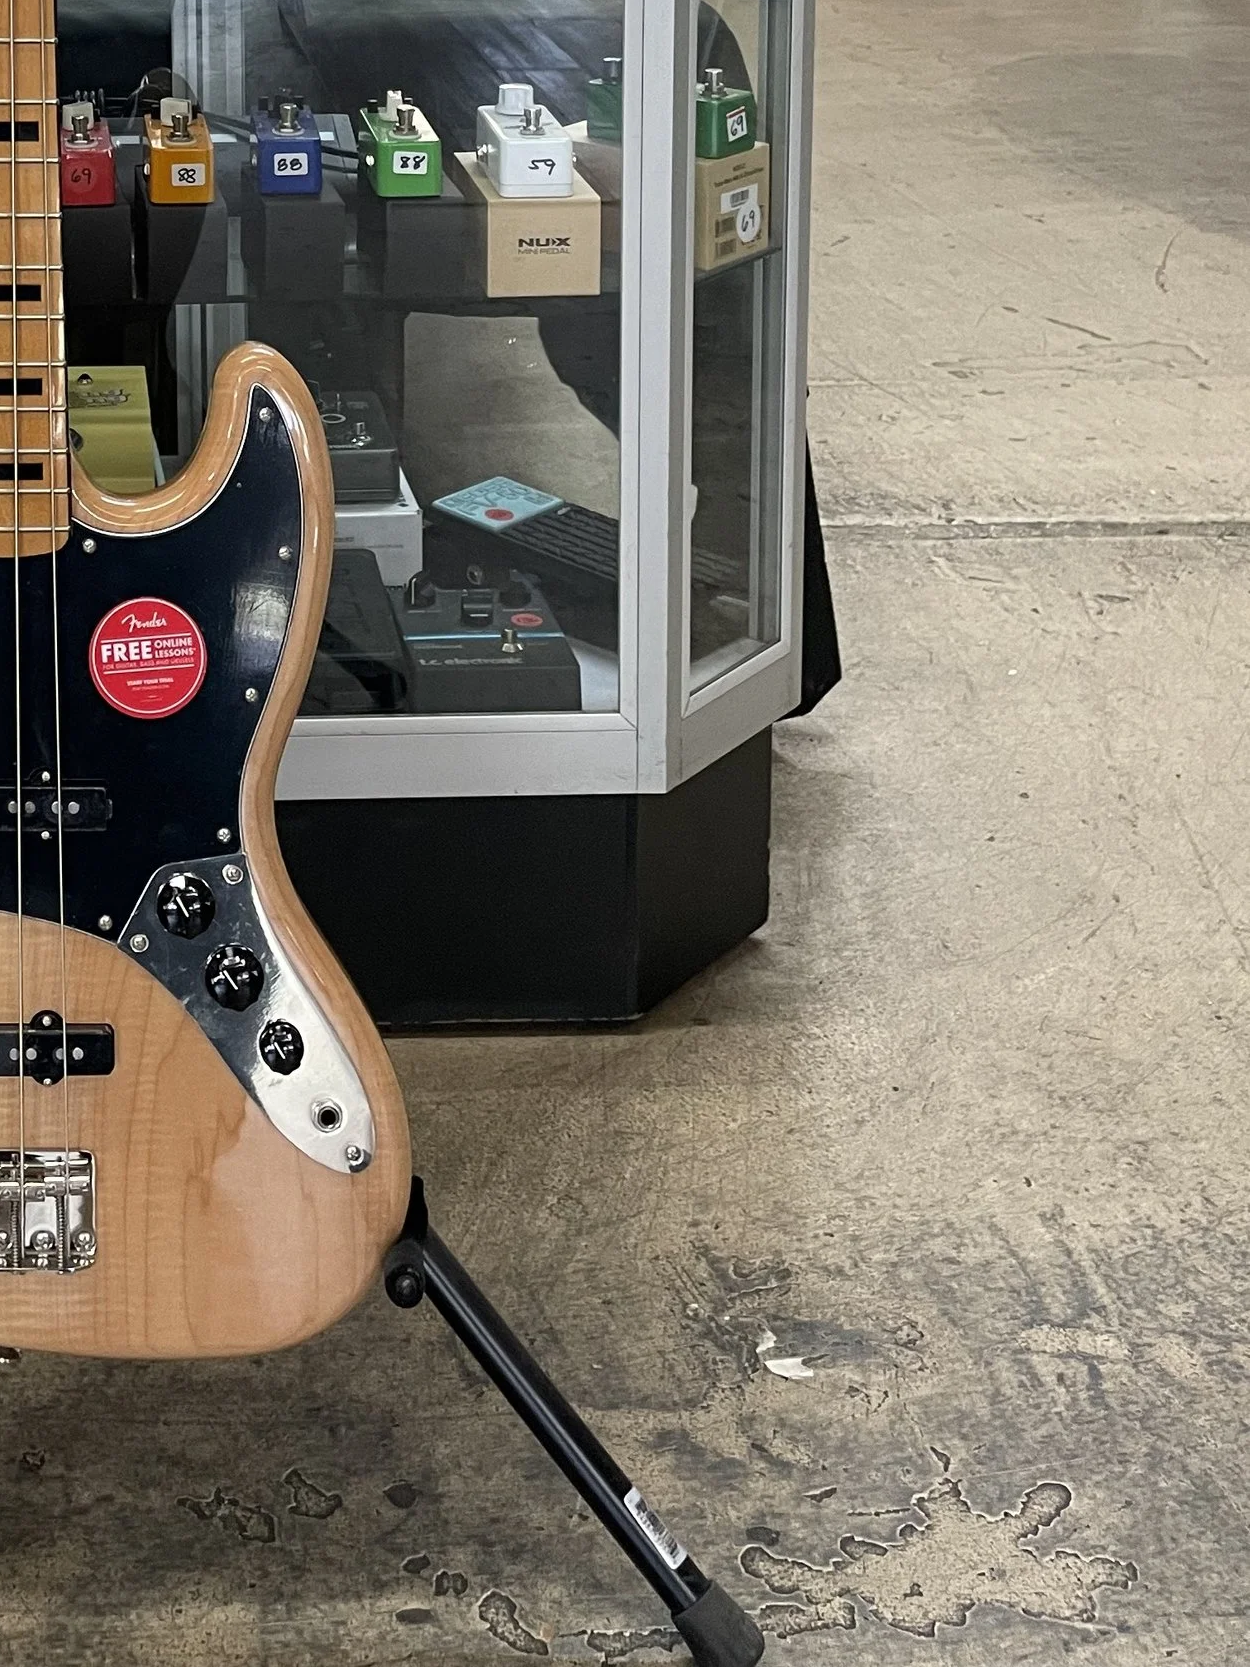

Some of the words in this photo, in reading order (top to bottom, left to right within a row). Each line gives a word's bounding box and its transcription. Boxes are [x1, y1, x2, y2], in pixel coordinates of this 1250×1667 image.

[729, 114, 745, 137] 69
[276, 158, 303, 172] 88
[399, 155, 426, 171] 88
[527, 158, 556, 176] 59
[70, 167, 92, 184] 69
[177, 167, 197, 184] 88
[740, 209, 755, 233] 69
[518, 237, 571, 248] NUX
[121, 611, 168, 633] Fender
[101, 640, 153, 664] FREE
[154, 637, 193, 650] ONLINE
[154, 647, 195, 659] LESSONS
